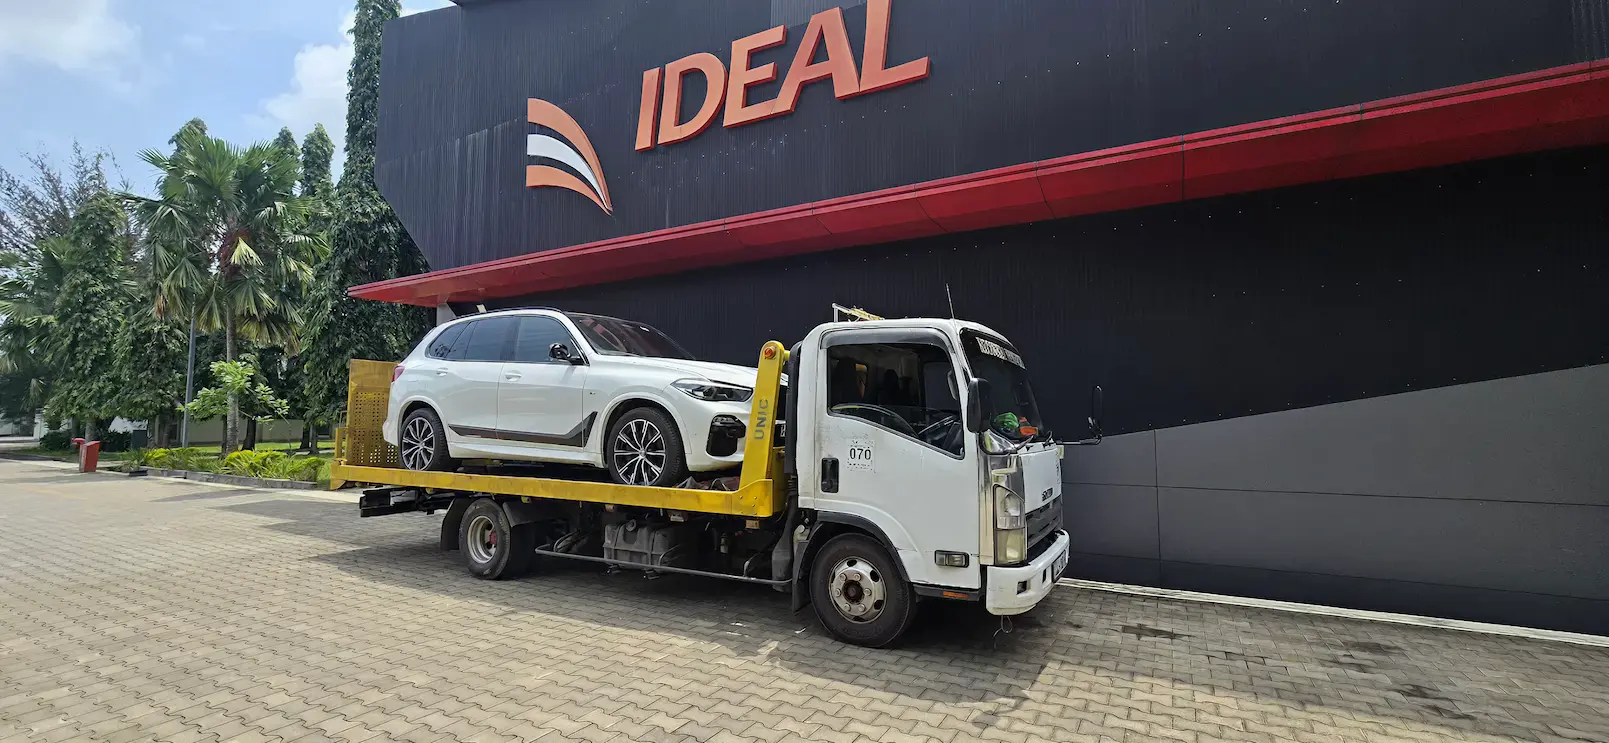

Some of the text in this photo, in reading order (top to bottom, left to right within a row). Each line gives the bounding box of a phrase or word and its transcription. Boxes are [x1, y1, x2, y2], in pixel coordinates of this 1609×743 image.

[635, 0, 930, 152] IDEAL
[754, 399, 769, 440] UNIC
[849, 447, 872, 461] 070
